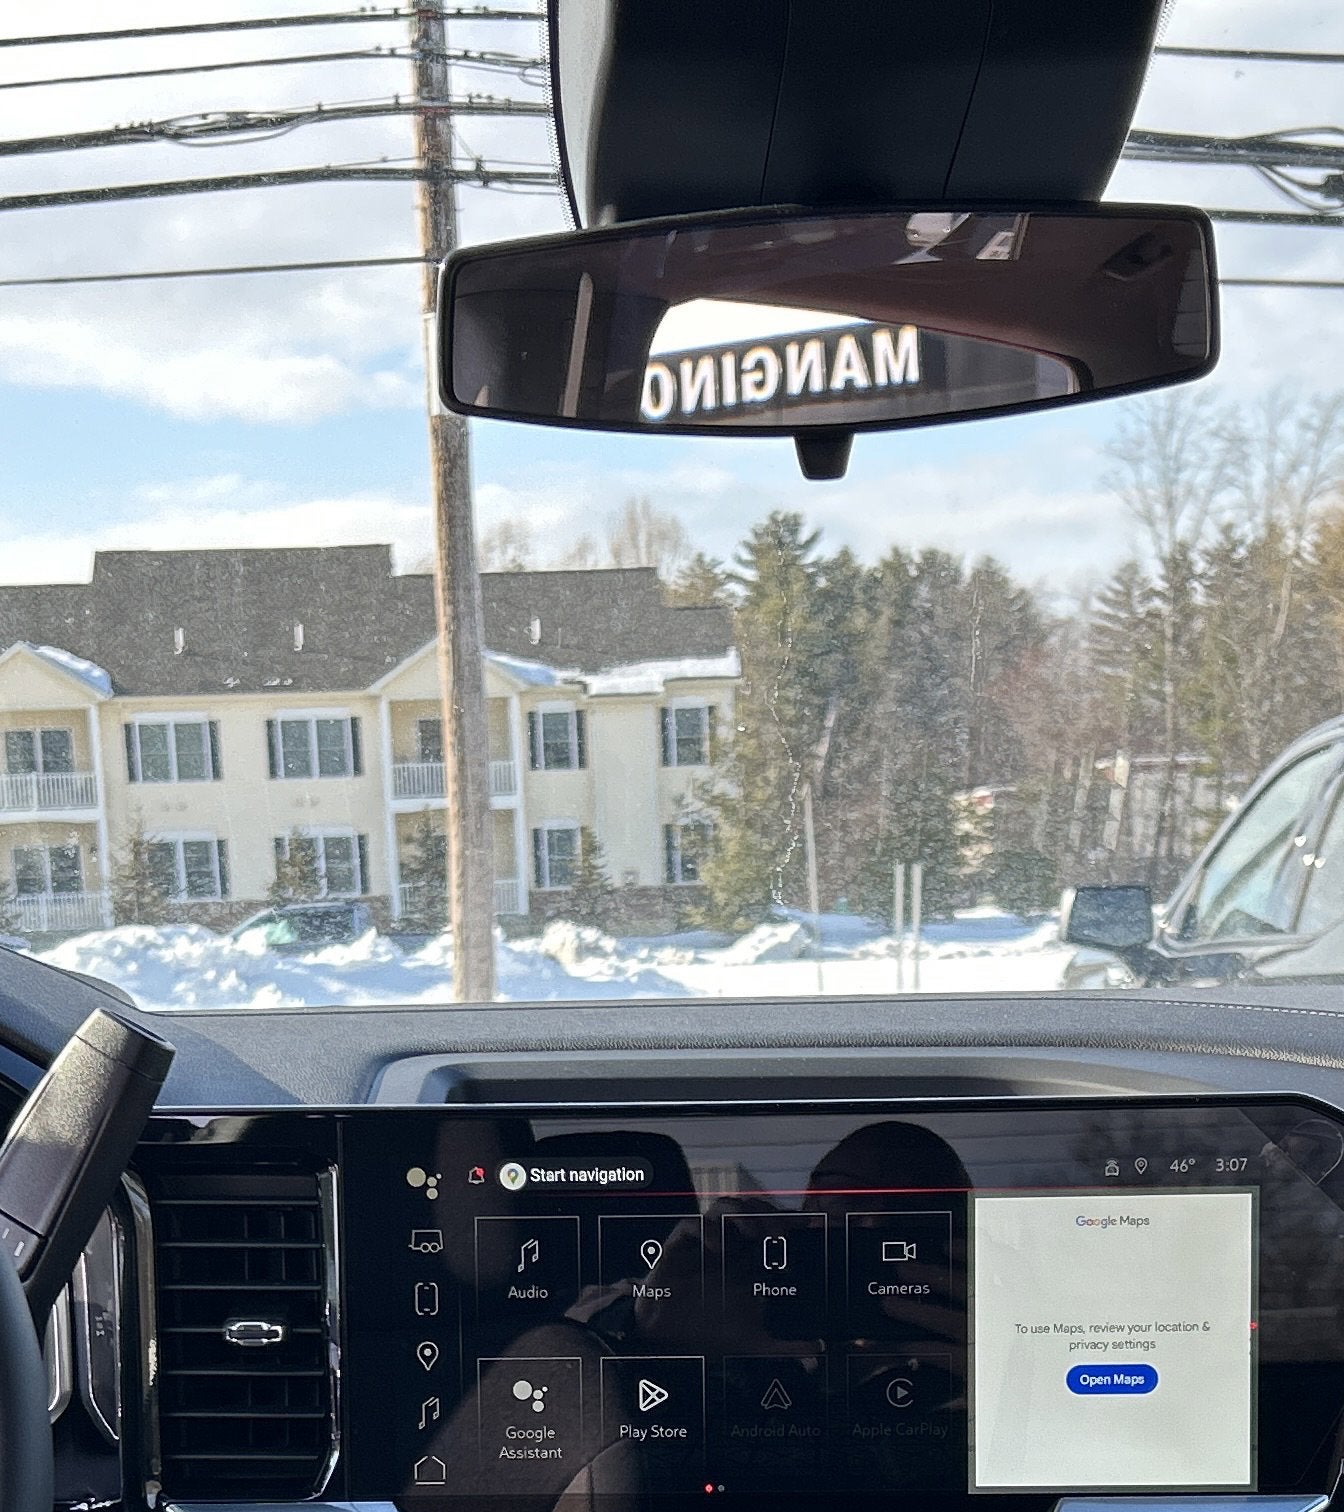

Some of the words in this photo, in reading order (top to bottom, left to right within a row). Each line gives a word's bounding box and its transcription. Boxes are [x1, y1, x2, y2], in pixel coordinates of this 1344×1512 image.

[1216, 1158, 1248, 1173] 3:07
[530, 1167, 566, 1183] Start
[569, 1167, 645, 1186] navigation
[1075, 1215, 1118, 1230] Google
[1119, 1215, 1150, 1229] Maps
[508, 1285, 549, 1300] Audio
[633, 1284, 671, 1301] Maps
[753, 1282, 797, 1296] Phone
[867, 1281, 930, 1296] Cameras
[1015, 1323, 1028, 1334] To
[1031, 1324, 1049, 1334] use
[1053, 1322, 1086, 1335] Maps,
[1089, 1322, 1124, 1334] review
[1127, 1323, 1151, 1335] your
[1155, 1321, 1199, 1333] location
[1202, 1321, 1211, 1332] &
[1069, 1338, 1109, 1351] privacy
[1112, 1338, 1156, 1352] settings
[1080, 1374, 1110, 1387] Open
[1114, 1373, 1145, 1387] Maps
[505, 1425, 556, 1442] Google
[619, 1423, 649, 1440] Play
[653, 1424, 687, 1438] Store
[731, 1423, 781, 1438] Android
[785, 1423, 821, 1438] Auto
[852, 1423, 887, 1438] Apple
[891, 1423, 949, 1438] CarPlay
[499, 1445, 563, 1460] Assistant
